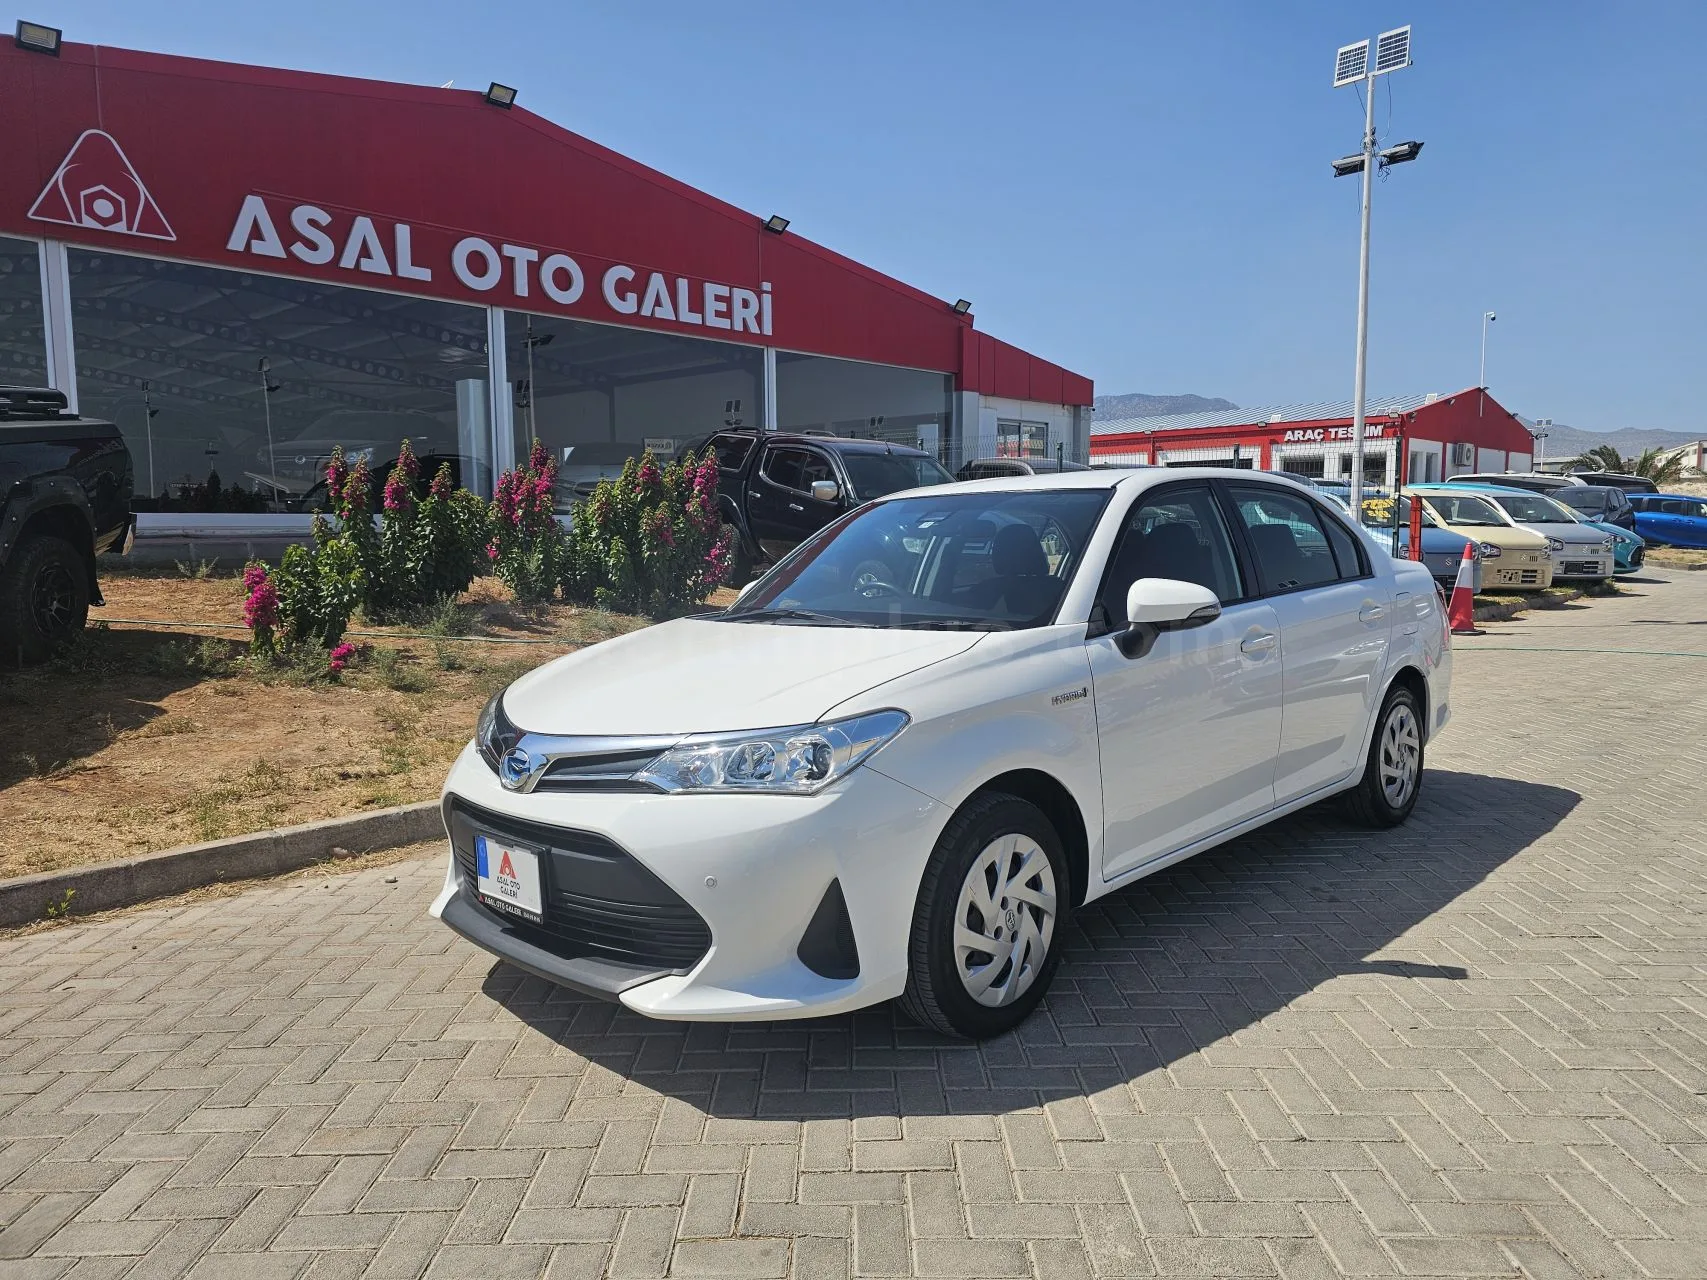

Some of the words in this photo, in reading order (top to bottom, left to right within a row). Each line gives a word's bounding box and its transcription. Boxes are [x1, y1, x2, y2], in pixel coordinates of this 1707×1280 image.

[225, 194, 432, 282] ASAL
[451, 237, 585, 304] OTO
[601, 265, 773, 336] GALERİ
[1284, 429, 1324, 442] ARAÇ
[1328, 424, 1384, 440] TESİM
[497, 876, 509, 886] ASAL
[510, 880, 520, 890] OTO
